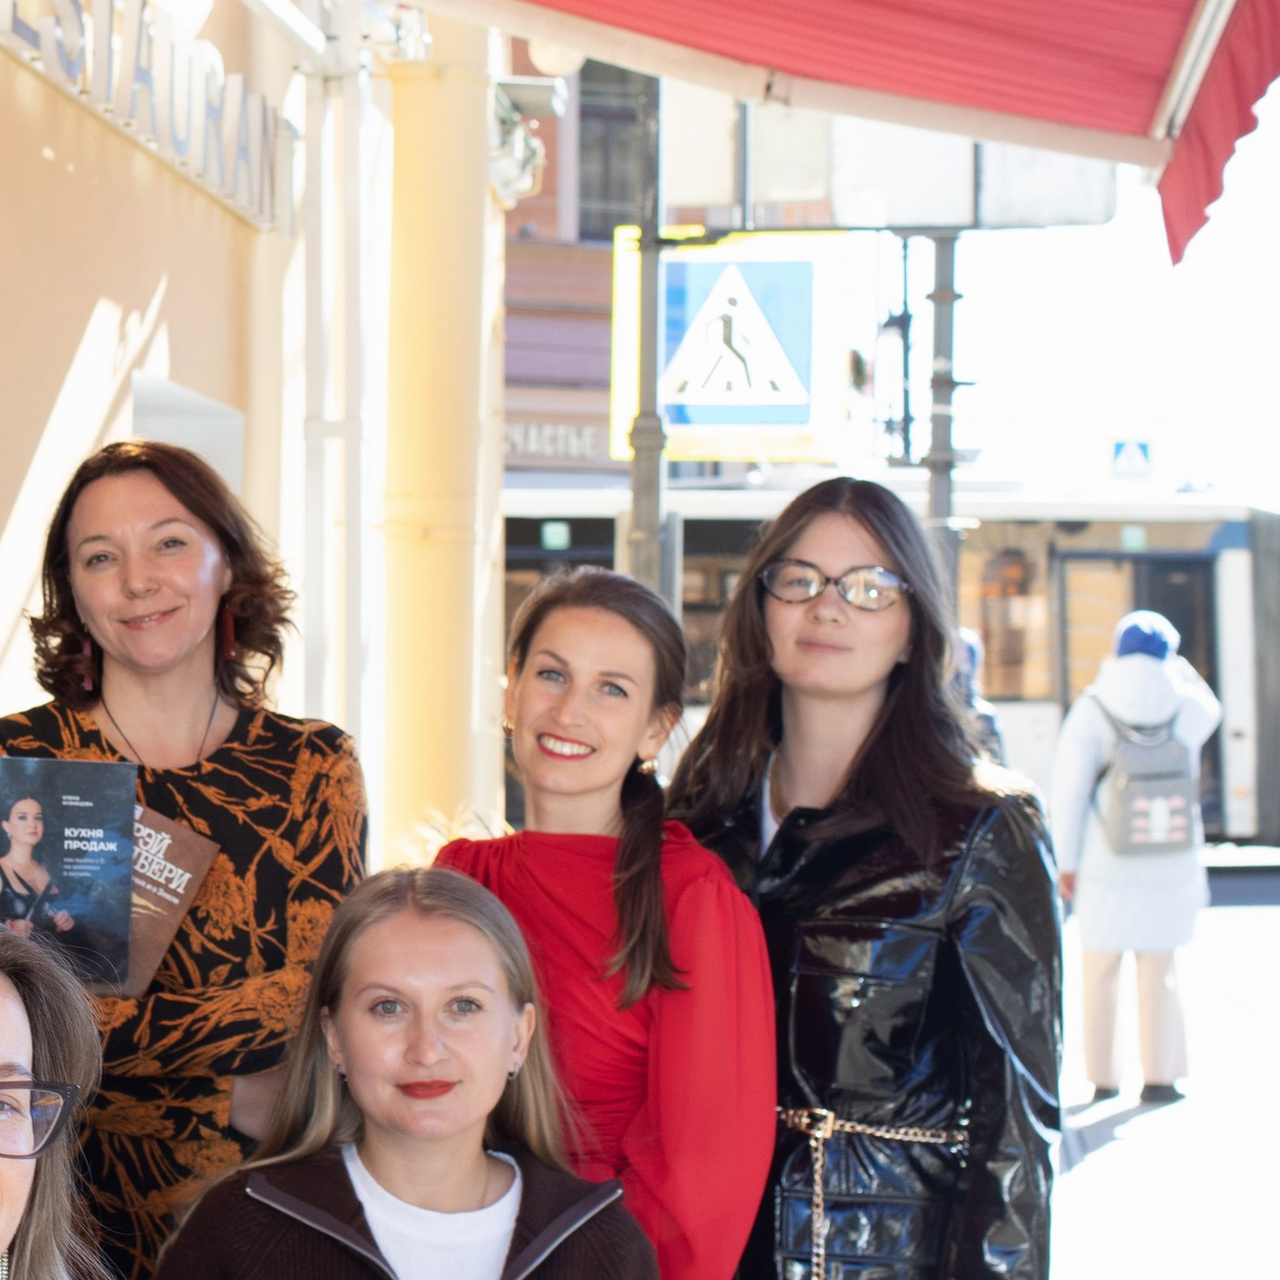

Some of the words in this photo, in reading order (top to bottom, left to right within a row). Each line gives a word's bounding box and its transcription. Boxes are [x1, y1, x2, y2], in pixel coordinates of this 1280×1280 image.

[503, 423, 597, 458] ЧАСТЬЕ
[64, 827, 104, 838] КУХНЯ
[64, 840, 118, 852] ПРОДАЖ
